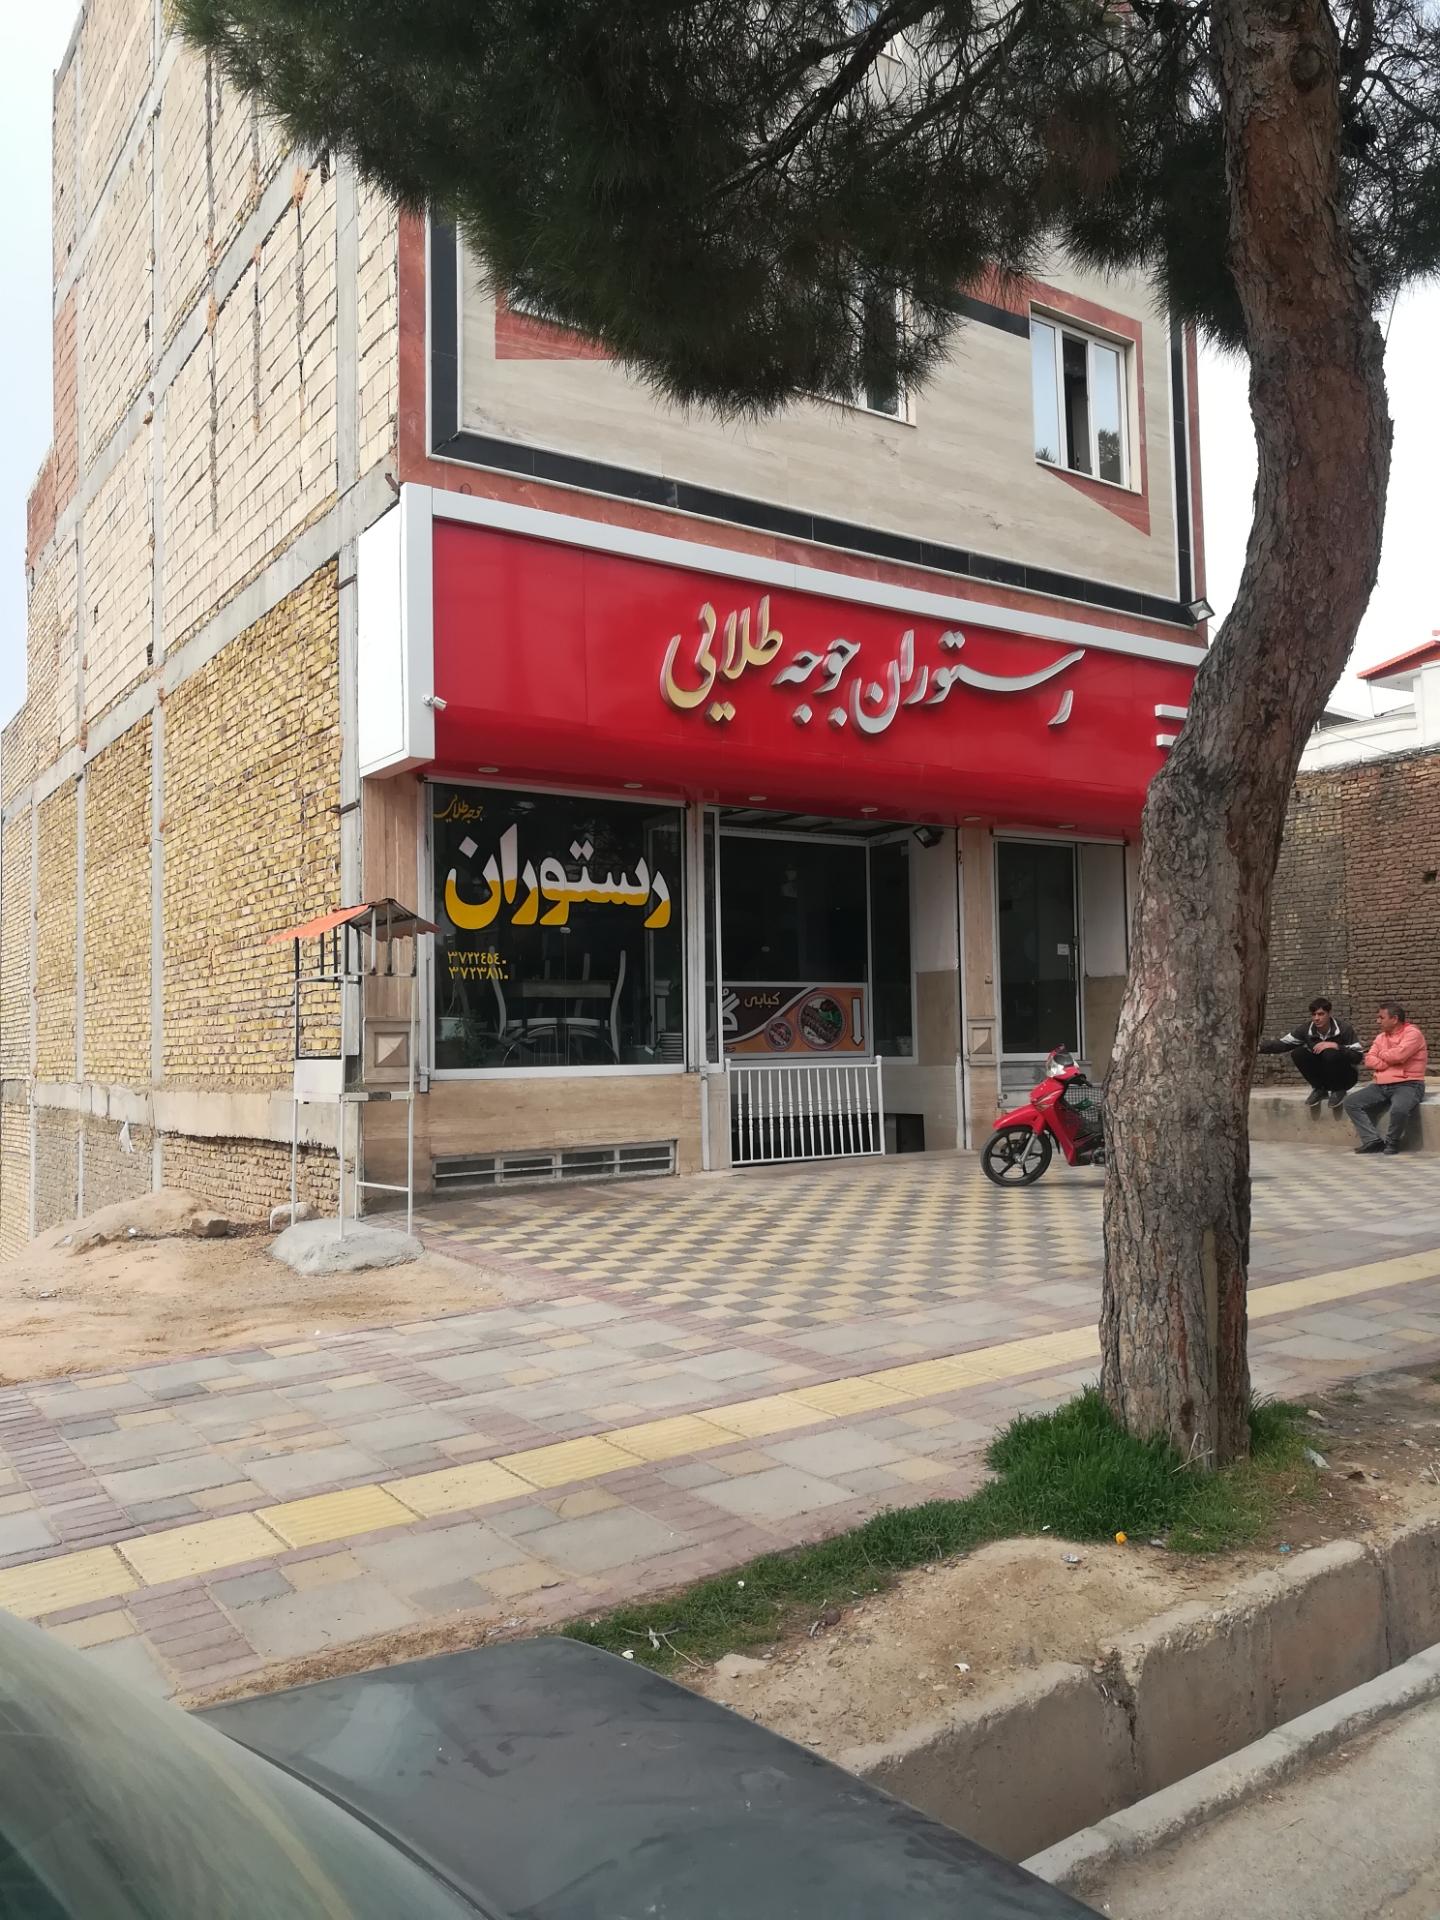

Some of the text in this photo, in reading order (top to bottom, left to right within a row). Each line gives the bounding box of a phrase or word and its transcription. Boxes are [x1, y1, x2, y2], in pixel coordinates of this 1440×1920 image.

[771, 638, 861, 728] جوجه
[848, 628, 1085, 735] رستوران
[445, 823, 671, 929] رستوران
[744, 991, 780, 1008] کبابی
